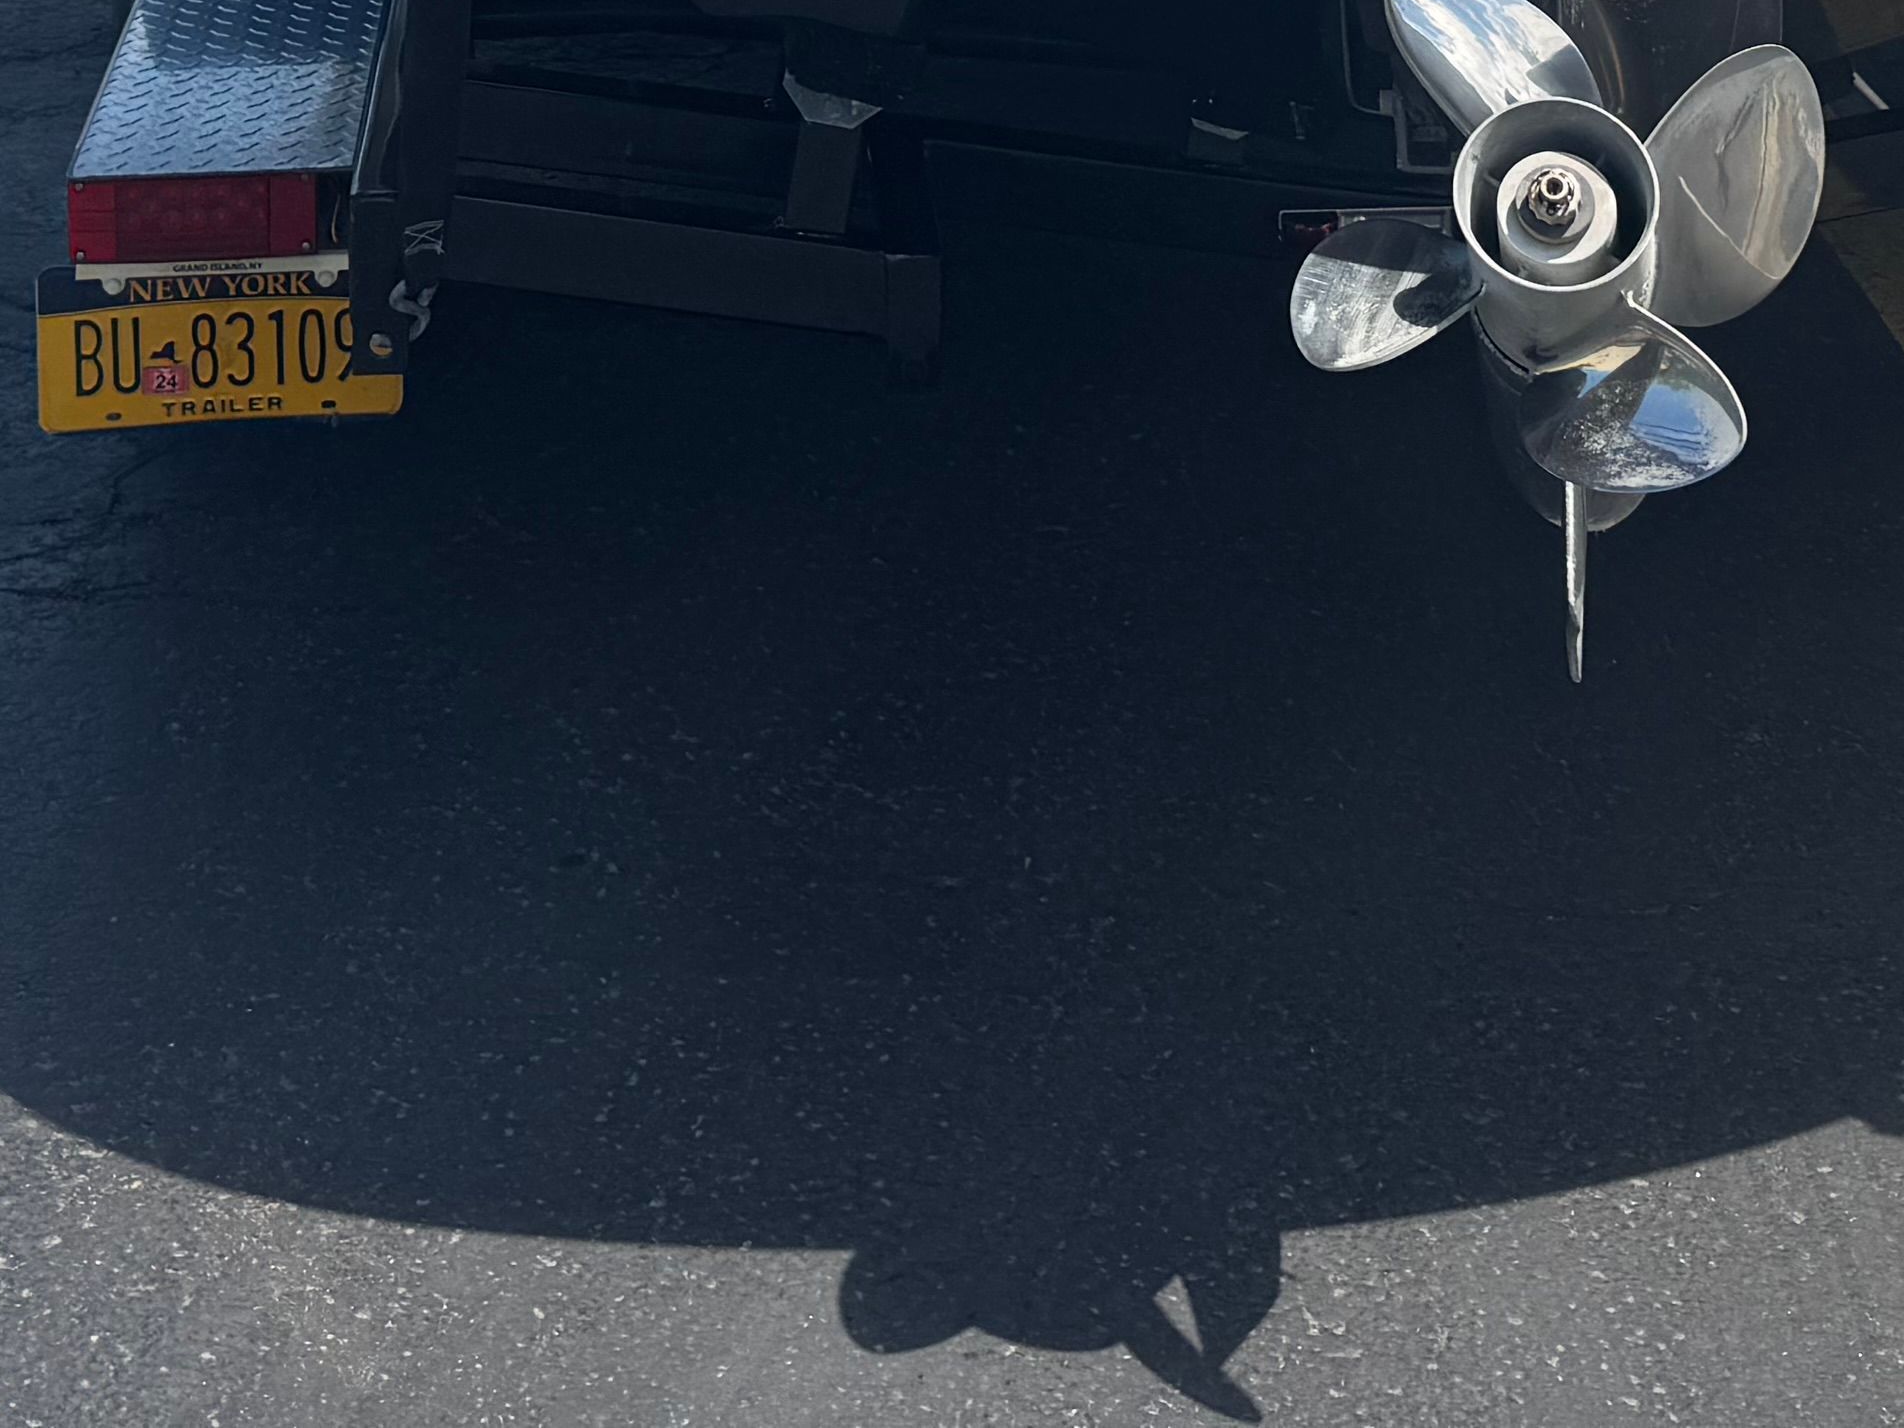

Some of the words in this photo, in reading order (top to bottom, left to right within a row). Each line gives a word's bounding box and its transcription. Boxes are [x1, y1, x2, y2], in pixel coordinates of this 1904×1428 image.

[172, 263, 208, 273] GRAND
[129, 278, 210, 302] NEW
[222, 272, 312, 297] YORK
[73, 316, 141, 398] BU
[191, 307, 355, 389] 83109
[155, 373, 178, 391] 24
[162, 396, 284, 418] TRAILER
